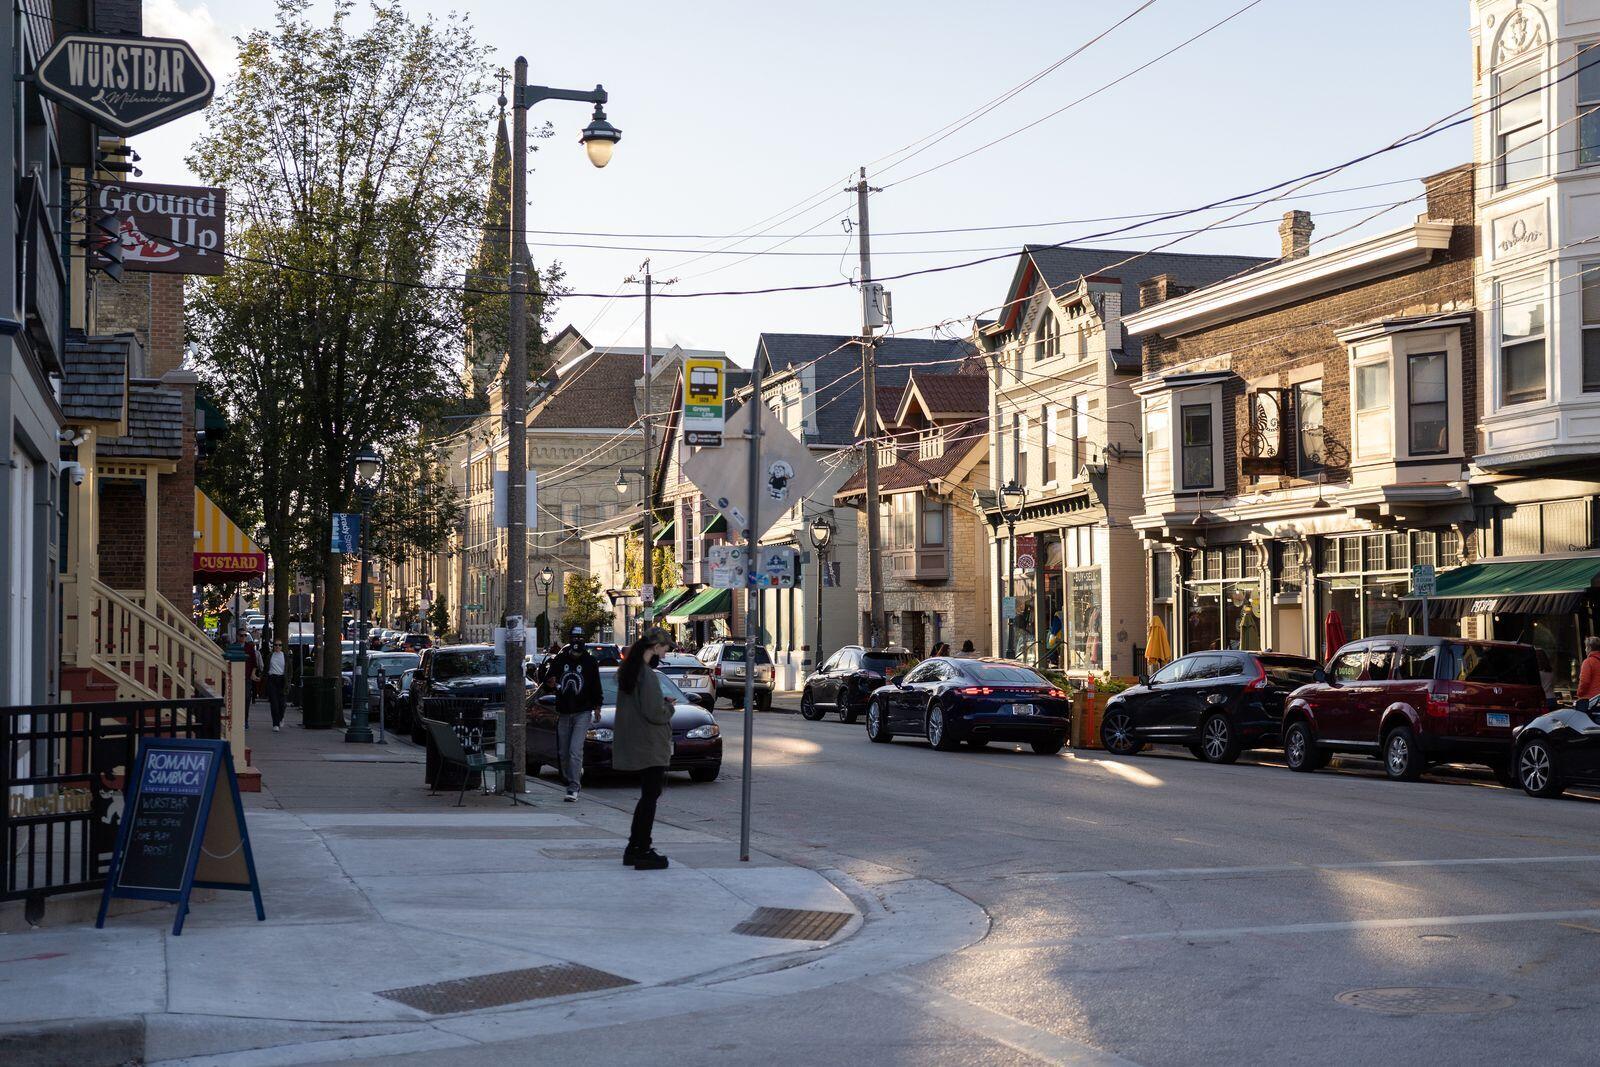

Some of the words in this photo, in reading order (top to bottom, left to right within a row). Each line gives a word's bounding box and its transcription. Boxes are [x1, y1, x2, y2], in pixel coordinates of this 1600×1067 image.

[67, 42, 185, 93] WÜRSTBAR
[105, 90, 171, 110] Milwaukee
[99, 185, 217, 217] Ground
[169, 217, 218, 256] Up
[339, 513, 350, 534] Brady
[200, 556, 258, 569] CUSTARD
[147, 754, 206, 770] ROMANA
